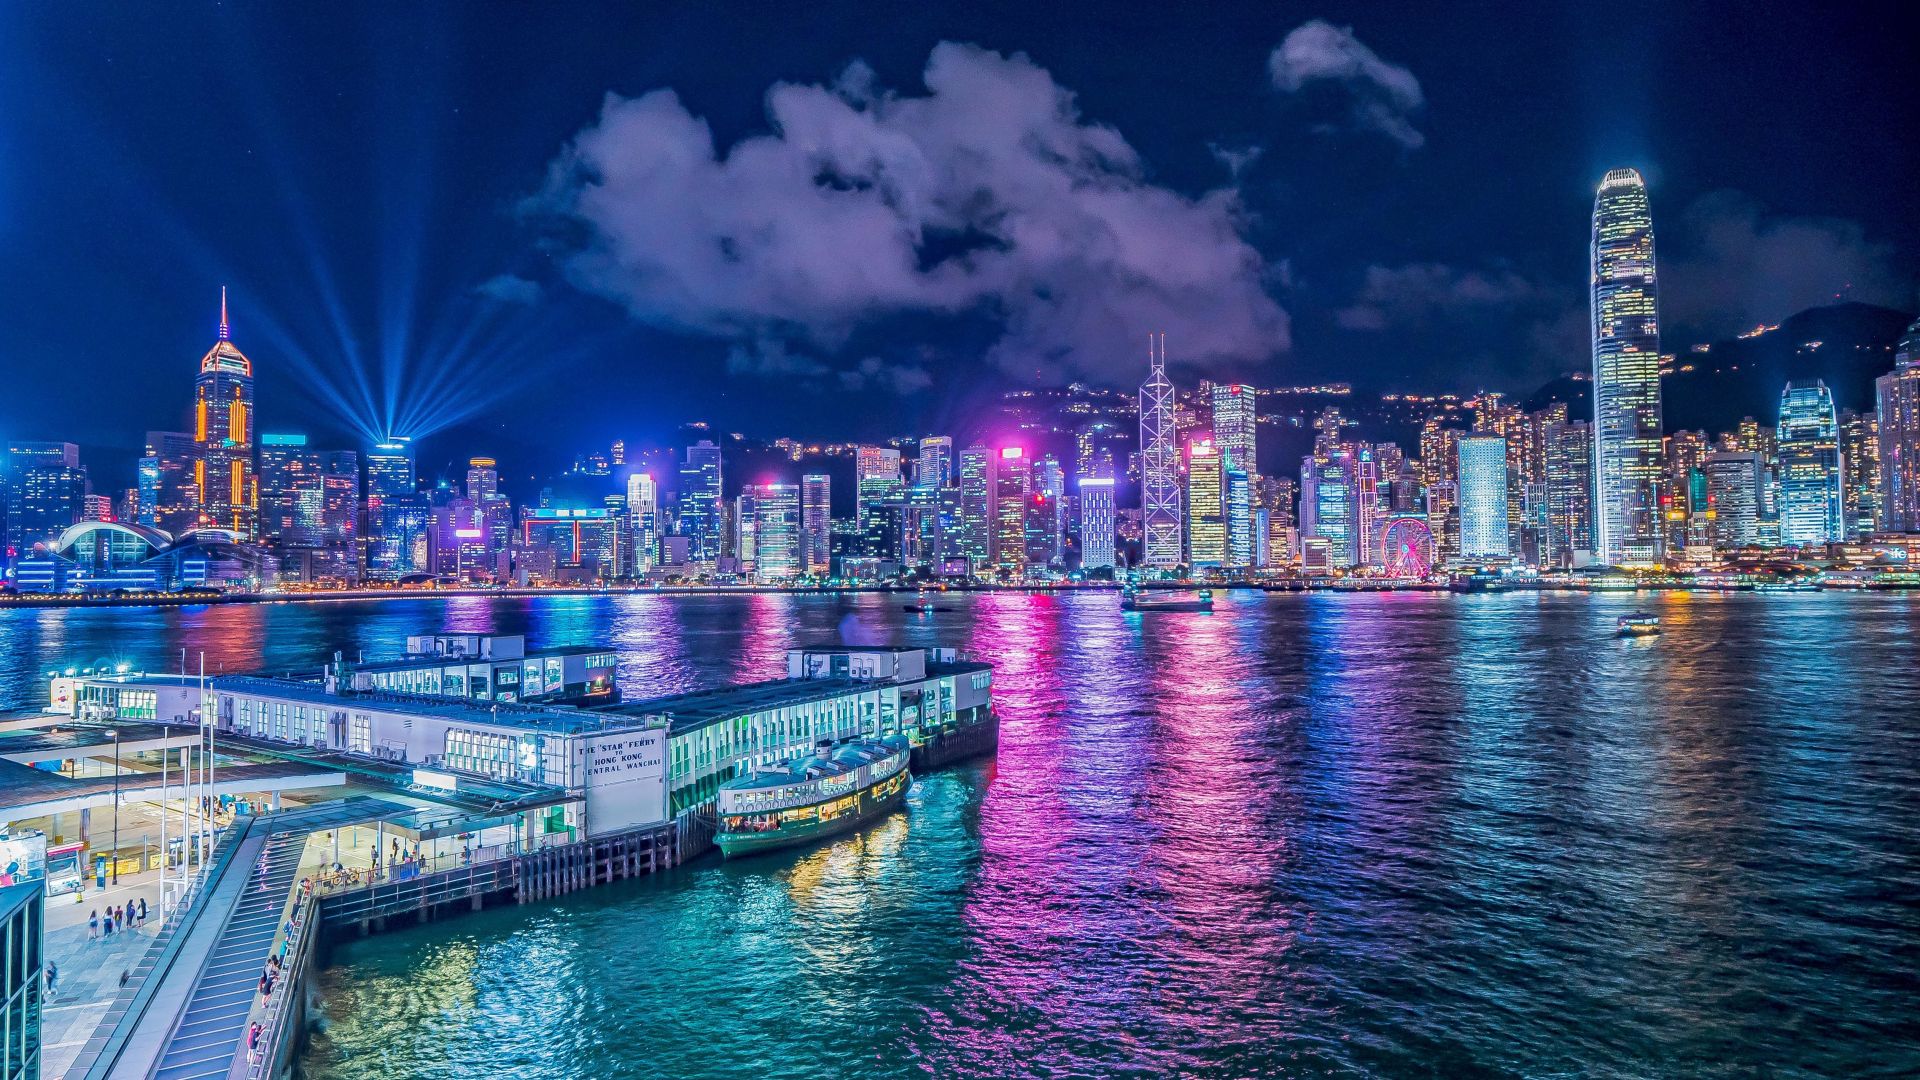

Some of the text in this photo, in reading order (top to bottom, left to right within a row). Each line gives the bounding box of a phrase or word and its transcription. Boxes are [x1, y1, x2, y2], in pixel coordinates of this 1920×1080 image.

[594, 753, 642, 766] HONG KONG
[582, 759, 661, 776] ENTRAL WANCHAI
